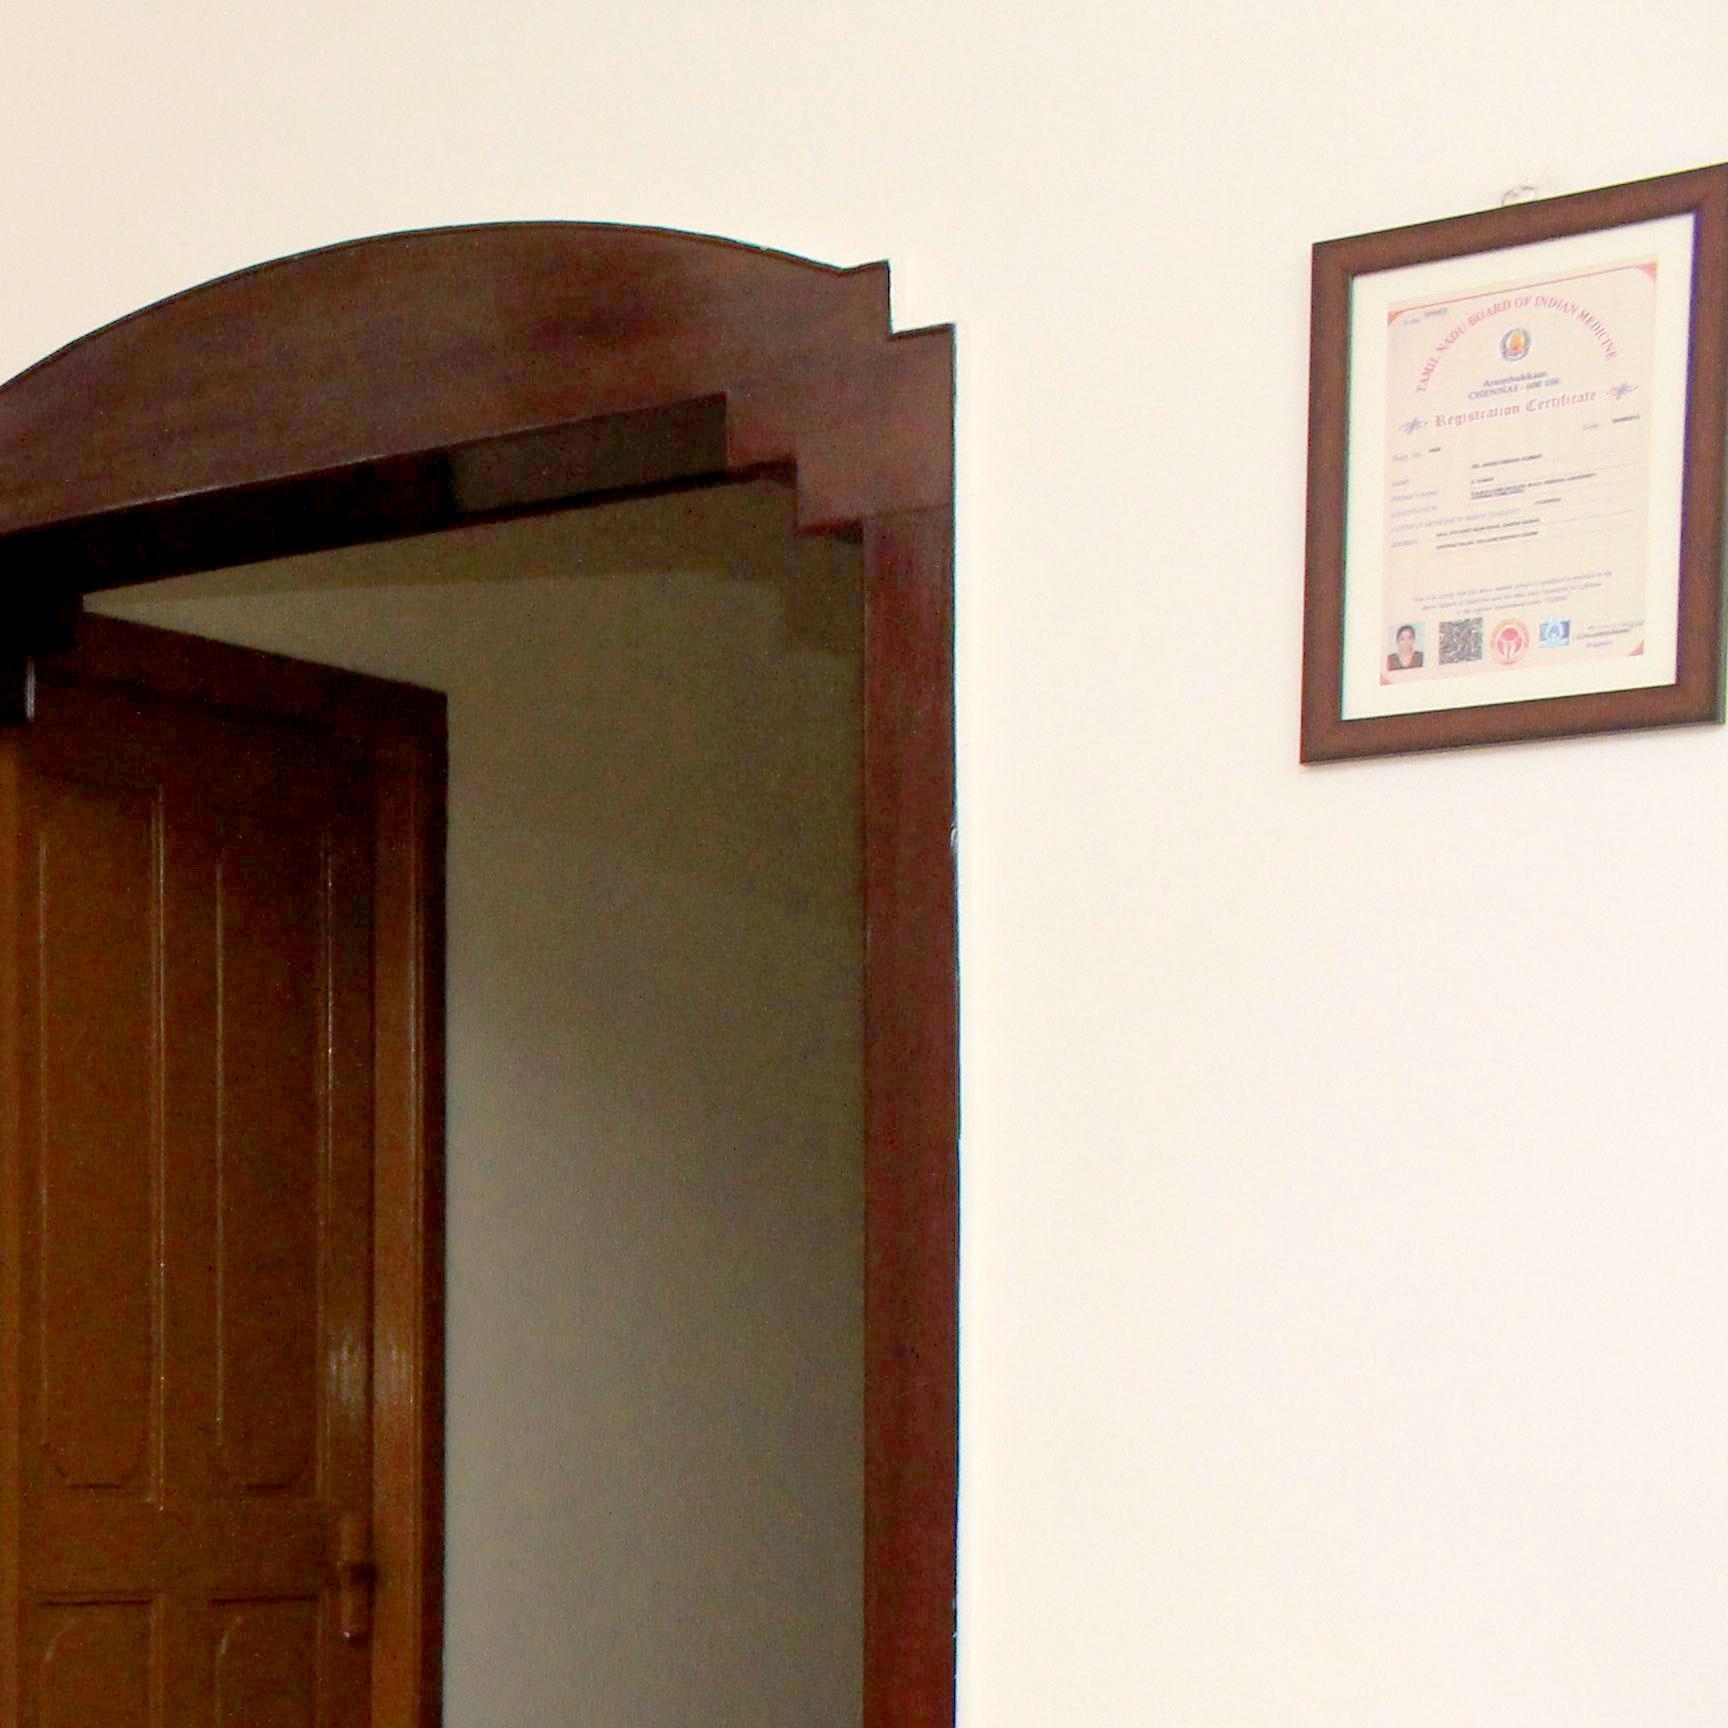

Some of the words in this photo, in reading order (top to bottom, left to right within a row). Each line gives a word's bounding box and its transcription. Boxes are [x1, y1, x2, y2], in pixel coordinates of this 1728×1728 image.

[1436, 324, 1467, 353] NADU
[1467, 299, 1512, 327] BOARD
[1514, 296, 1533, 308] OF
[1534, 296, 1578, 315] INDIAN
[1577, 309, 1618, 361] MEDICINE
[1435, 405, 1520, 428] Registration
[1525, 392, 1597, 412] Certificate
